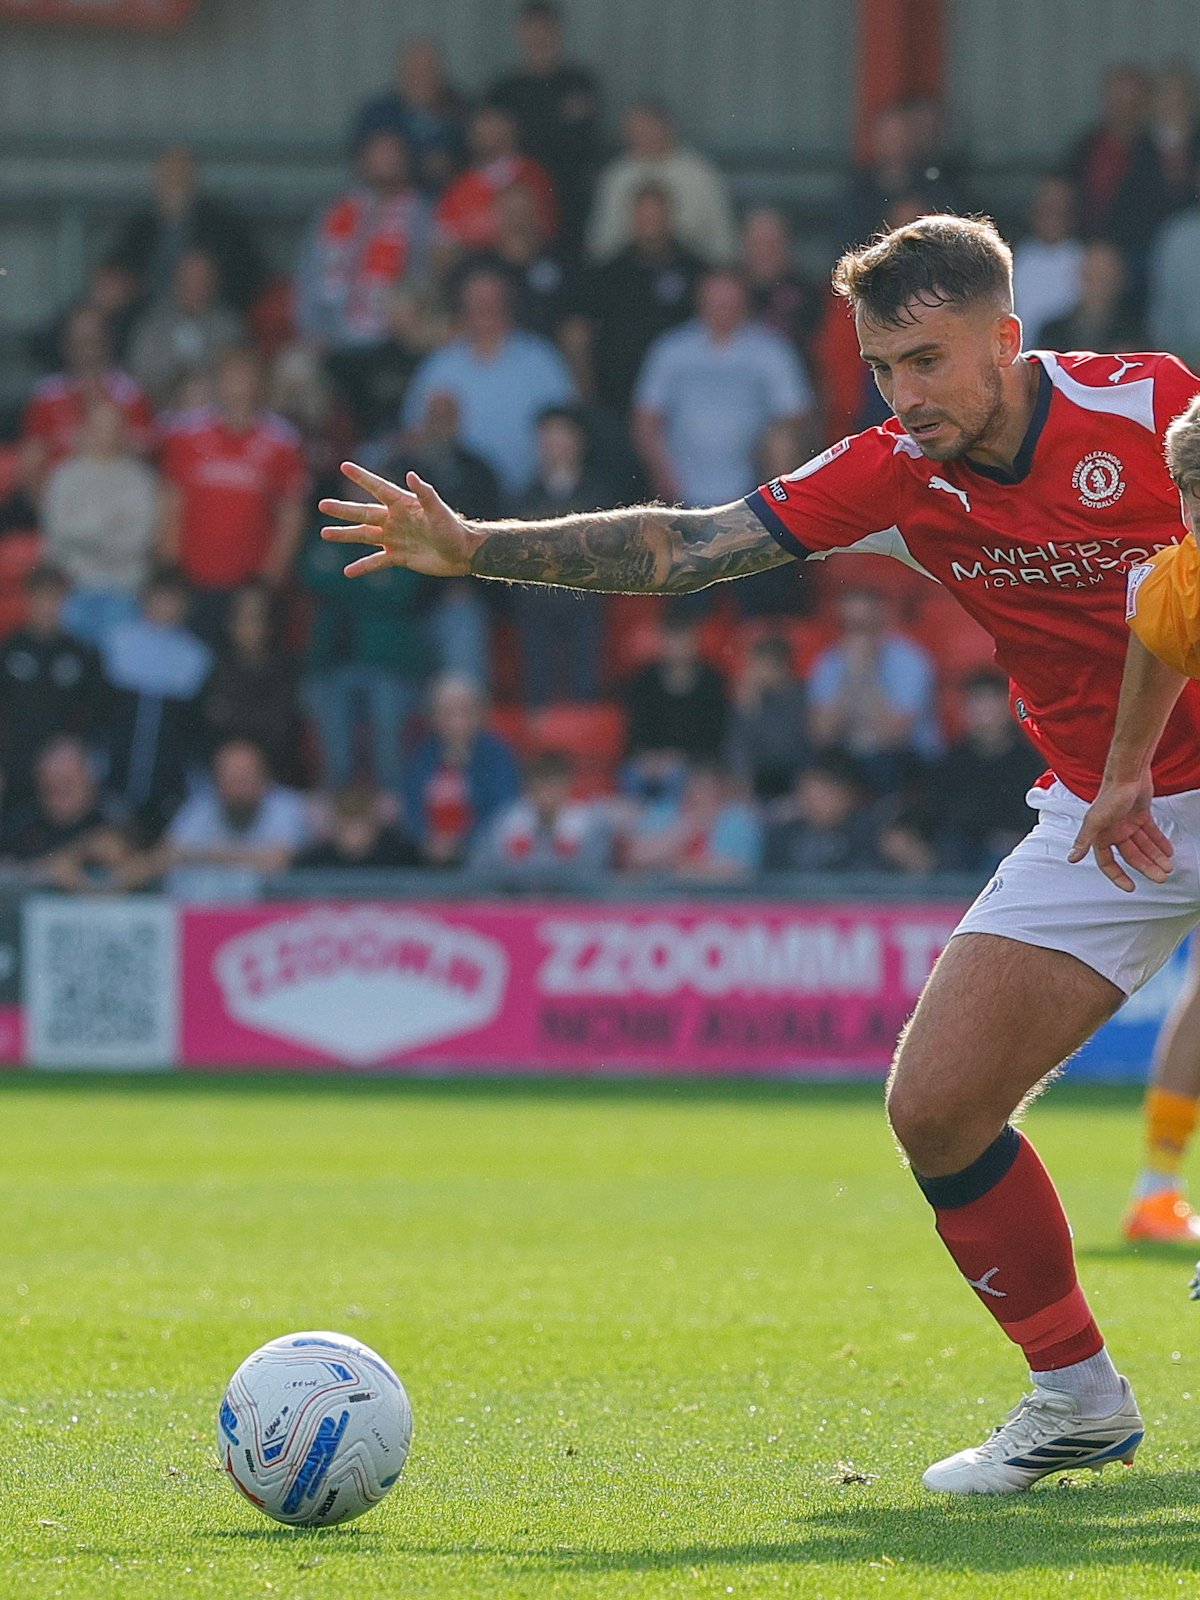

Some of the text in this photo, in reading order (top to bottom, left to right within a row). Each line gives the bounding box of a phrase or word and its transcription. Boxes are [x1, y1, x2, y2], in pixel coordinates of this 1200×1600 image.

[1072, 451, 1124, 489] CREWE ALEXANDRA
[1078, 482, 1125, 508] FOOTBALL CLUB
[538, 920, 880, 996] ZZOOMM
